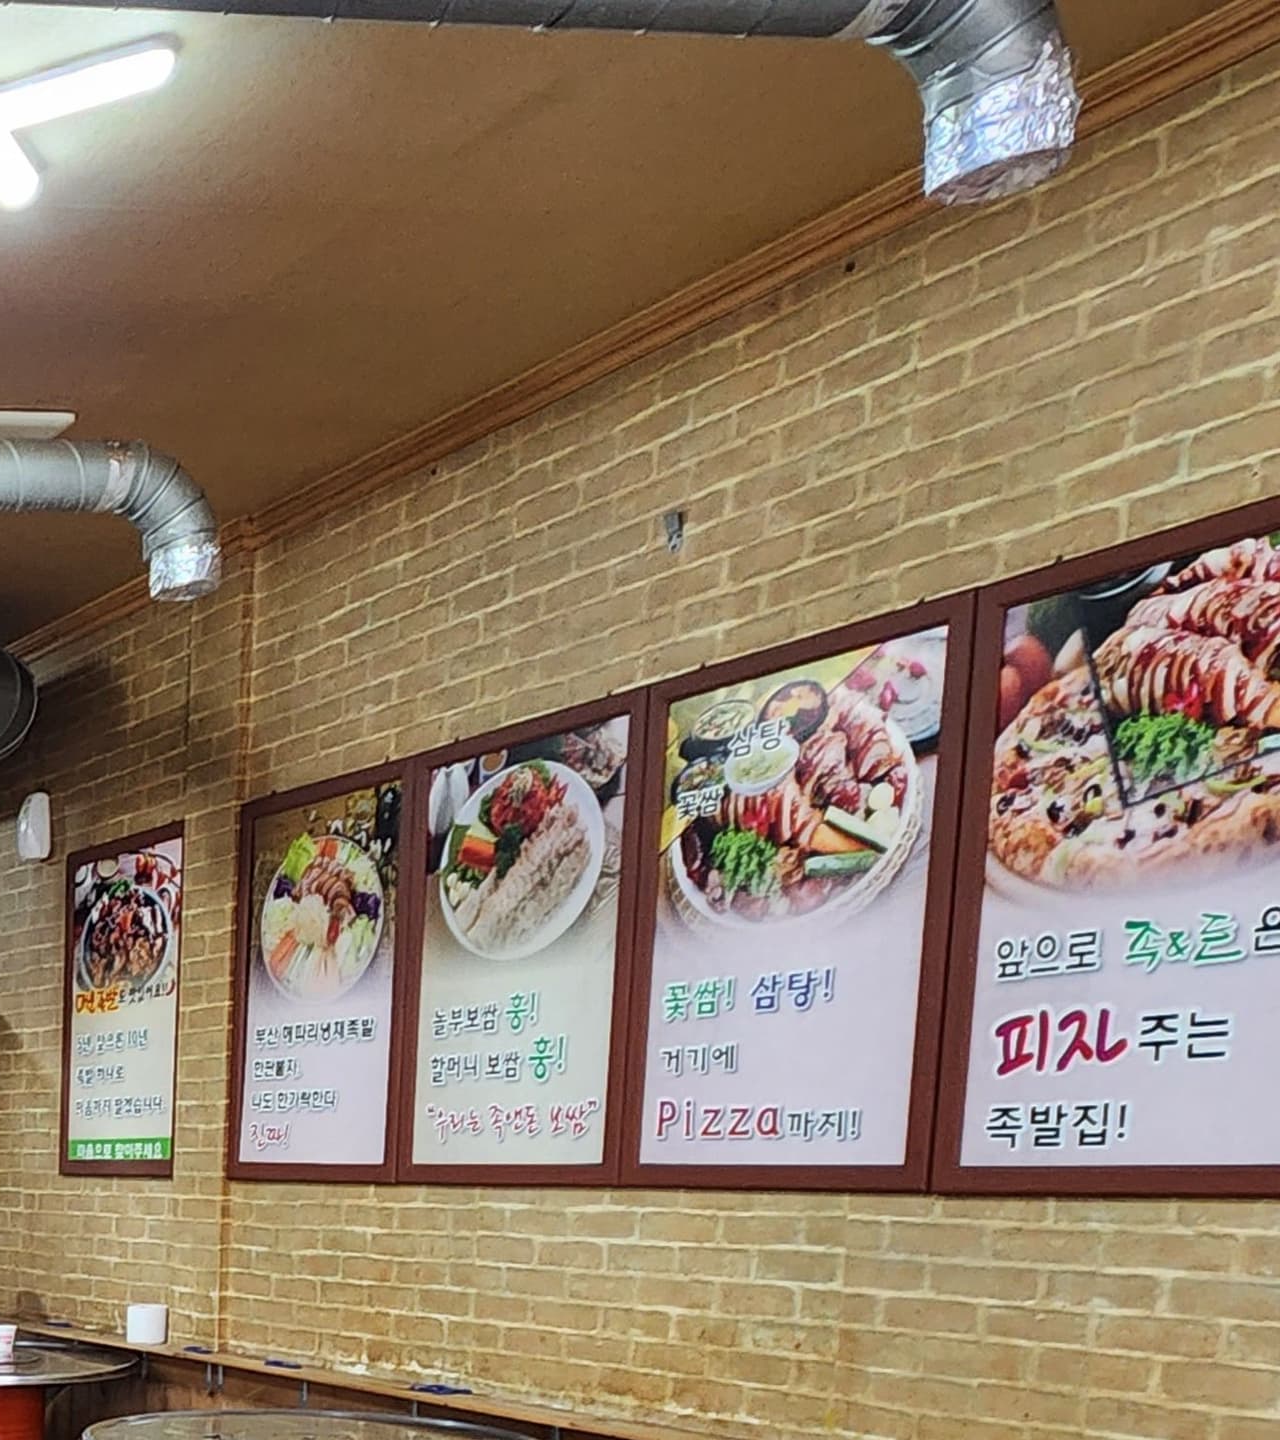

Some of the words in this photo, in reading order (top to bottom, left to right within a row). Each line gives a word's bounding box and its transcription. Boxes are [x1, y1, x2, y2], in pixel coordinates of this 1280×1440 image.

[731, 719, 787, 757] 삼탕
[997, 931, 1097, 979] 앞으로
[664, 978, 734, 1021] 꽃쌈!
[751, 968, 834, 1010] 삼탕!
[256, 1026, 278, 1046] 부산
[434, 1004, 498, 1036] 놀부보쌈
[995, 1007, 1128, 1076] 피자
[1139, 1012, 1229, 1061] 주는
[431, 1053, 478, 1084] 할머니
[485, 1052, 520, 1079] 보쌈
[661, 1045, 736, 1074] 거기에
[252, 1092, 273, 1109] 나도
[986, 1102, 1127, 1149] 족발집!
